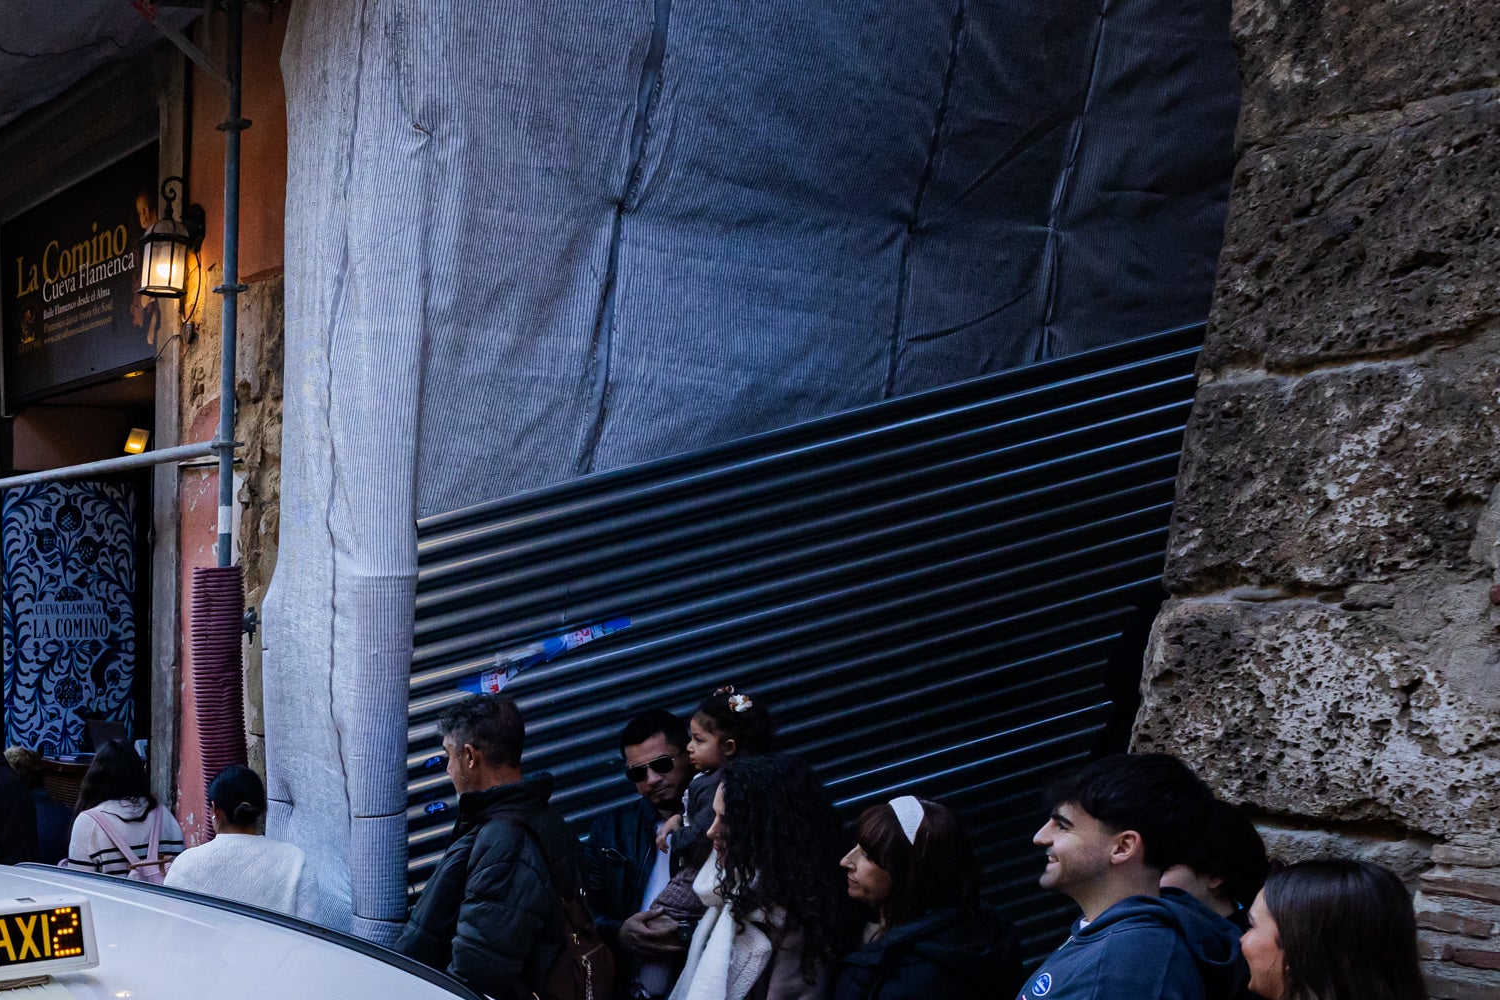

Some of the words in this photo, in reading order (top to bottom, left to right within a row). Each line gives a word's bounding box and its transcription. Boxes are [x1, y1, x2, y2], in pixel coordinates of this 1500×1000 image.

[16, 256, 39, 298] La
[42, 222, 128, 285] Comino
[42, 277, 77, 303] Cueva
[79, 252, 135, 289] Flamenca
[96, 287, 111, 300] Alma
[36, 604, 59, 616] CUEVA
[62, 603, 102, 615] FLAMENCA
[33, 619, 51, 639] LA
[56, 617, 109, 638] COMINO
[51, 907, 81, 957] 2
